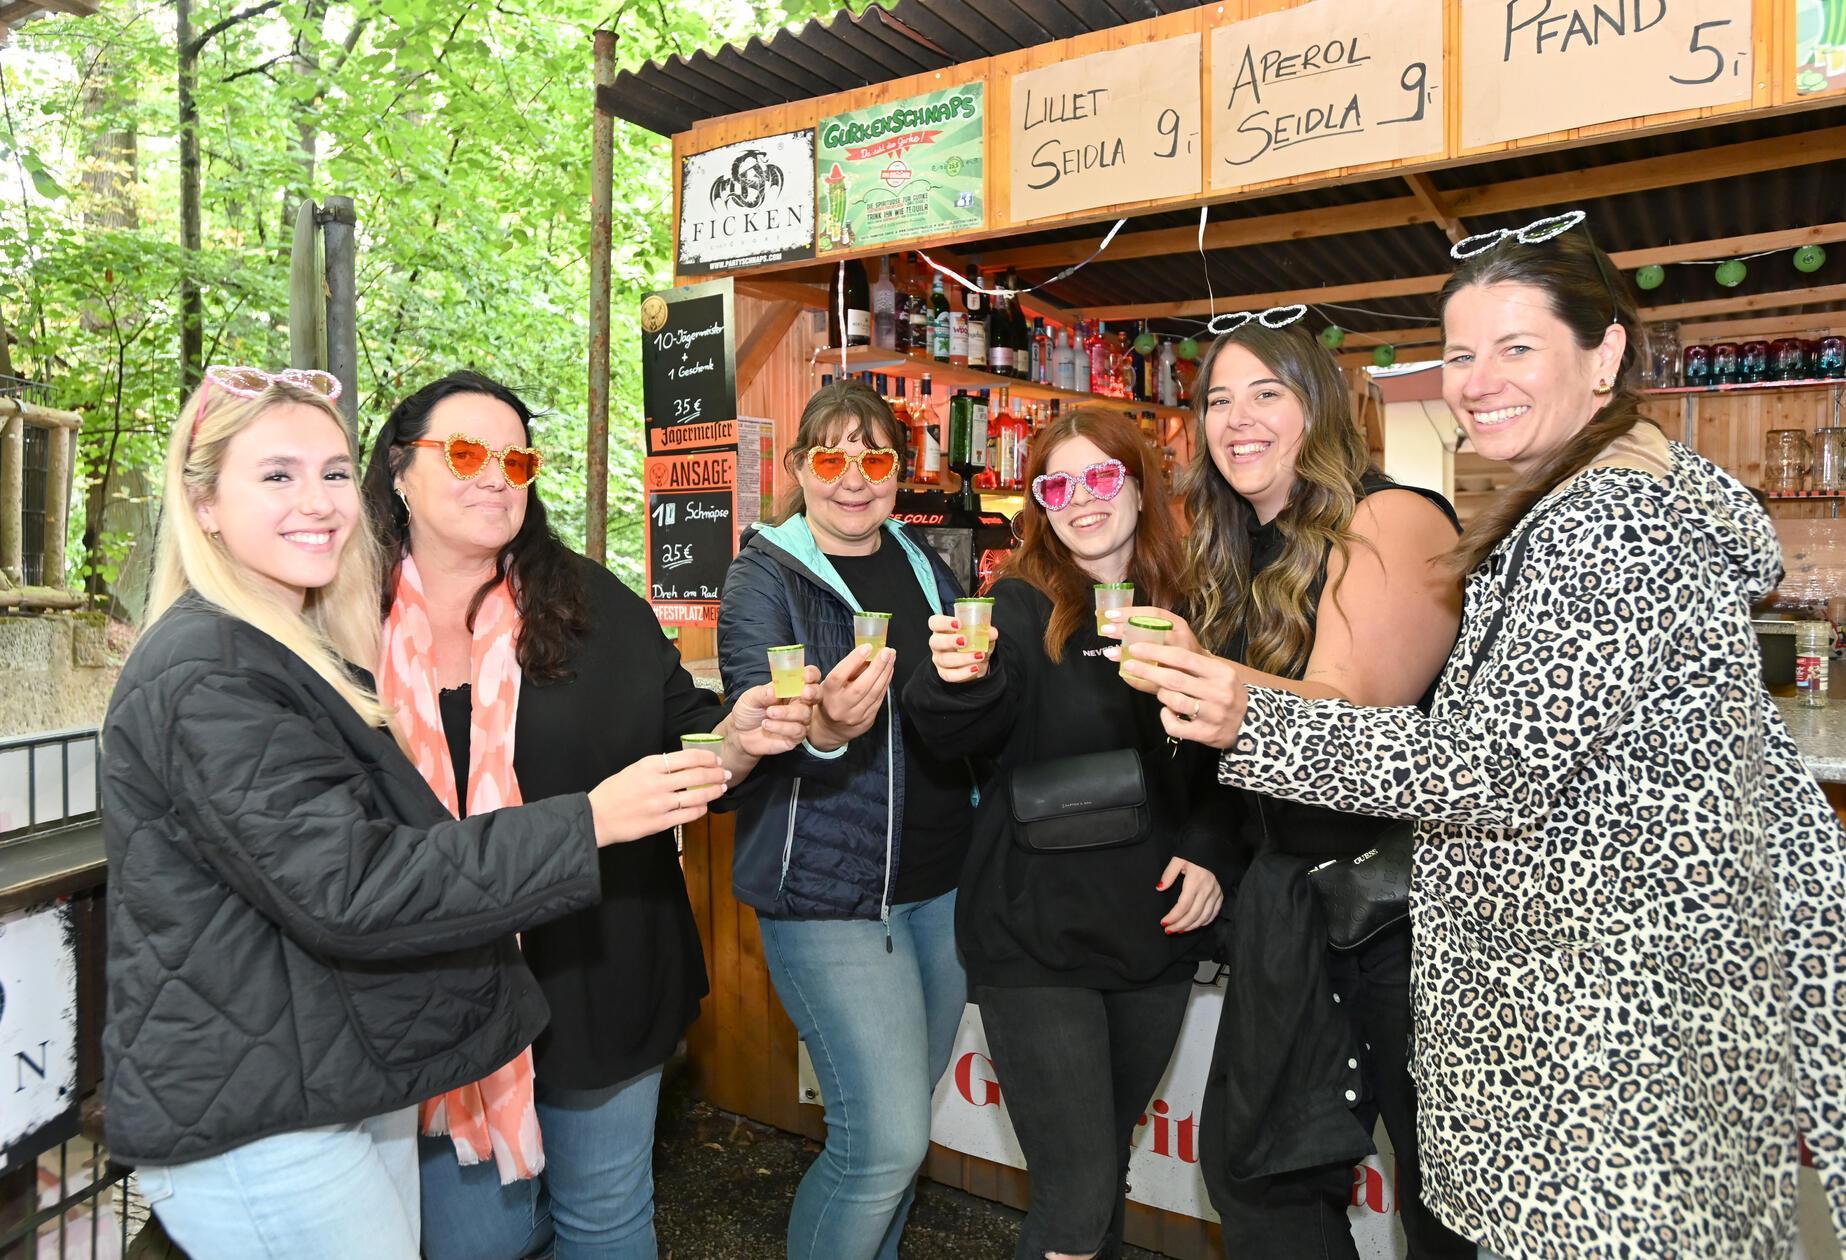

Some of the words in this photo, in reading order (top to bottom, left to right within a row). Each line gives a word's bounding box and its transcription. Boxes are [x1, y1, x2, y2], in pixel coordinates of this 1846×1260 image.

[1503, 0, 1667, 61] PFAND
[1227, 37, 1371, 110] APEROL
[823, 96, 976, 149] GURKENSCHNAPS
[1023, 88, 1109, 131] LILLET
[1224, 93, 1362, 165] SEIDLA
[1027, 137, 1126, 190] SEIDLA
[693, 205, 802, 241] FICKEN
[668, 368, 675, 380] 1
[678, 358, 714, 378] Geschenk
[670, 459, 732, 487] ANSAGE:
[685, 501, 729, 523] Schnäpse
[904, 514, 944, 524] COLD!
[652, 584, 677, 599] Dreh
[684, 590, 697, 598] am
[700, 585, 718, 599] Rad
[1353, 848, 1379, 865] GUESS
